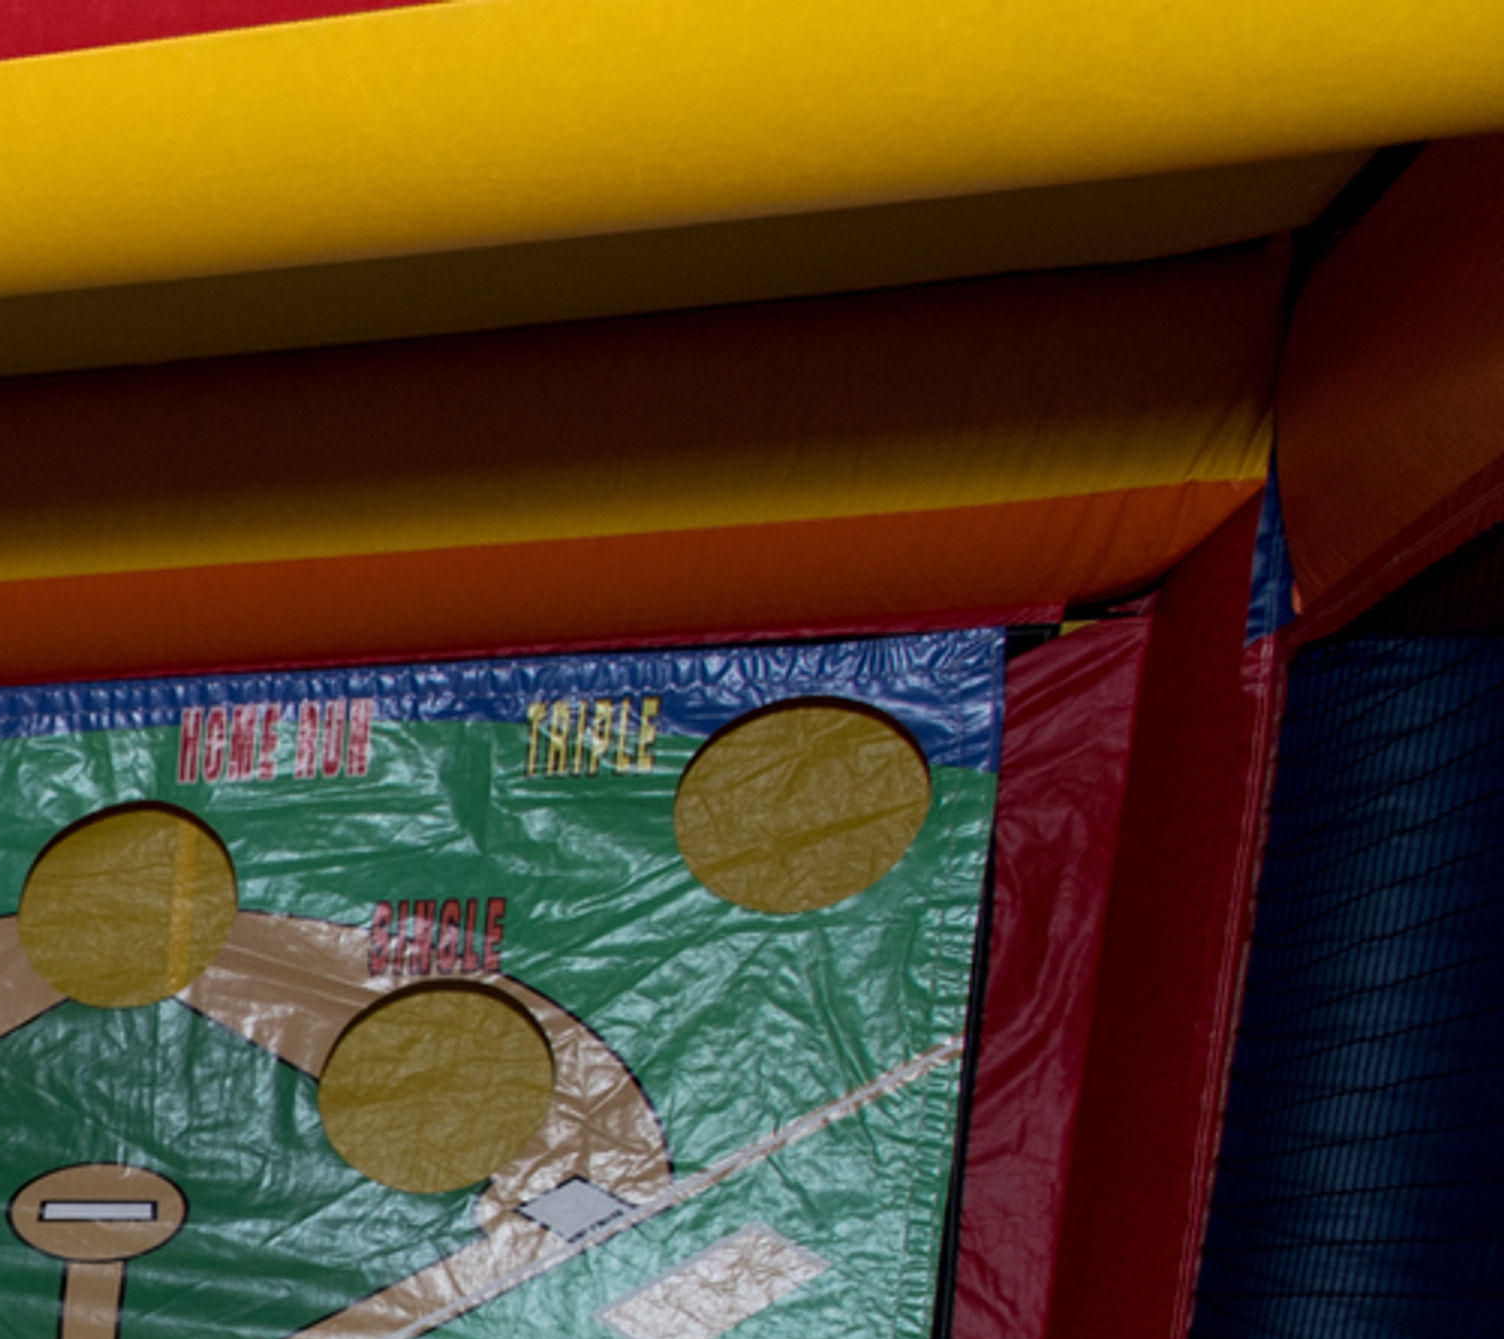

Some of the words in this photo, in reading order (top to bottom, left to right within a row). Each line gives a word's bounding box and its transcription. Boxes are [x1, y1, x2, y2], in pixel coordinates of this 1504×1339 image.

[176, 702, 281, 784] HOME
[294, 697, 374, 780] RUN
[525, 695, 662, 778] TRIPLE
[368, 897, 507, 976] SINGLE
